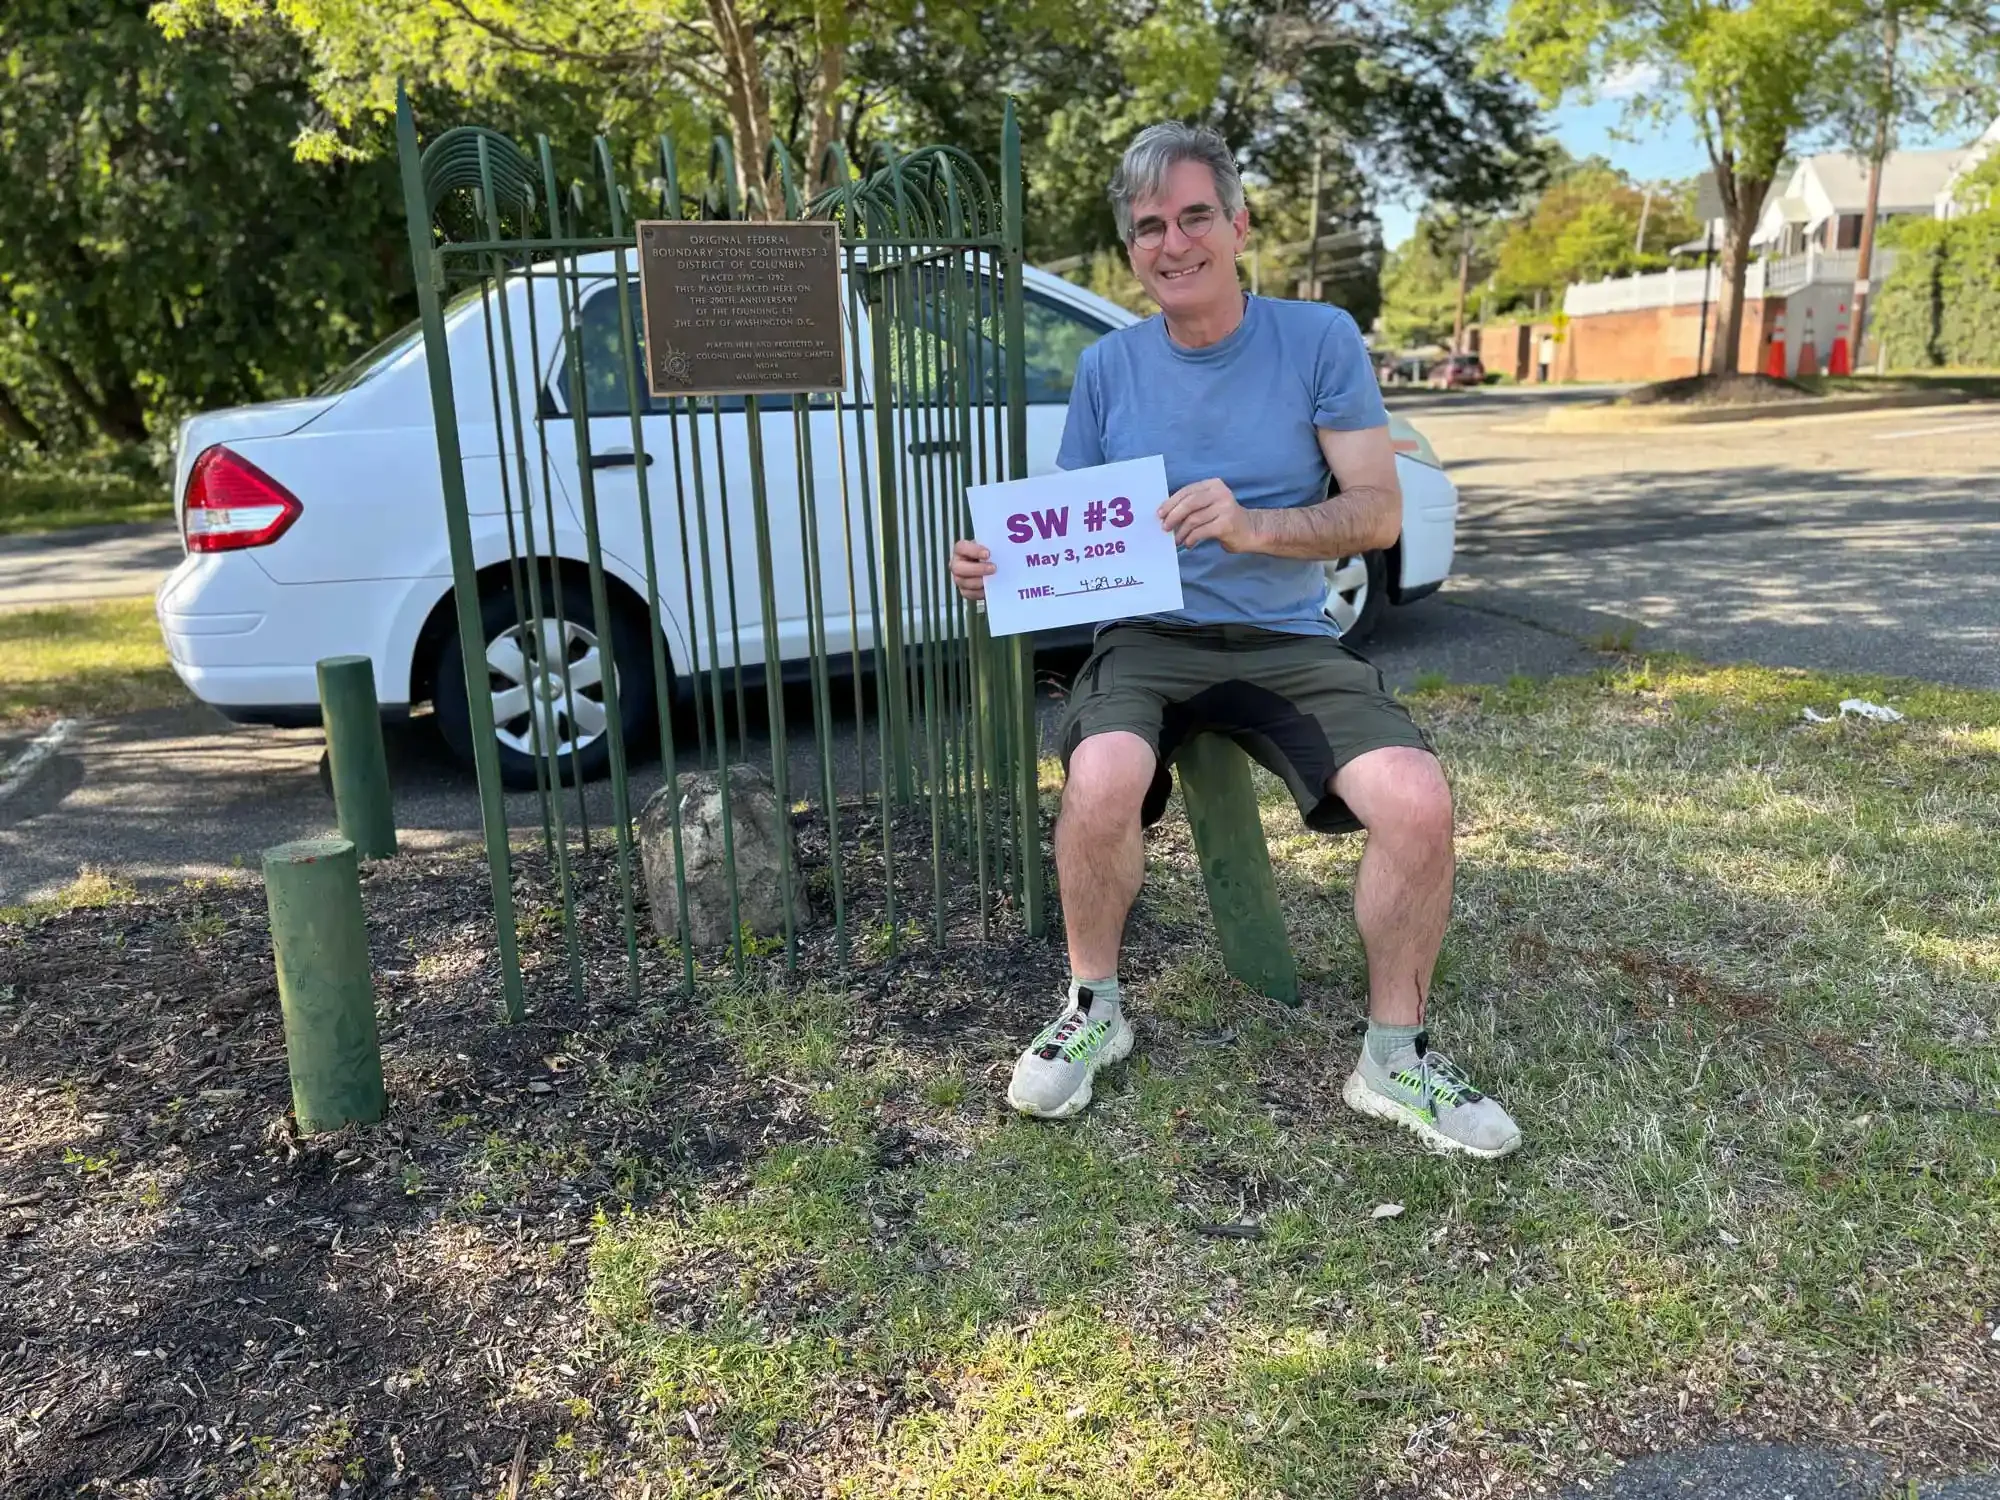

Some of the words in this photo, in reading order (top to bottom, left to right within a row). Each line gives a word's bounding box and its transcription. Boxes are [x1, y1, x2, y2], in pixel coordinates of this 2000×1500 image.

[690, 235, 742, 245] ORIGINAL
[747, 235, 791, 245] FEDERAL
[652, 248, 713, 257] BOUNDARY
[718, 247, 751, 257] STONE
[756, 247, 817, 257] SOUTHWEST
[677, 260, 725, 270] DISTRICT
[730, 260, 744, 270] OF
[750, 260, 806, 270] COLUMBIA
[701, 274, 734, 282] PLACED
[767, 274, 785, 282] 1792
[675, 284, 695, 294] THIS
[699, 284, 733, 294] PLAQUE
[736, 284, 769, 293] PLACED
[797, 284, 811, 292] ON
[690, 296, 706, 305] THE
[709, 296, 736, 304] 200TH
[739, 296, 798, 305] ANNIVERSARY
[696, 308, 707, 316] OF
[712, 308, 729, 316] THE
[732, 308, 778, 316] FOUNDING
[674, 320, 692, 328] THE
[696, 320, 716, 328] CITY
[719, 320, 732, 328] OF
[736, 318, 793, 327] WASHINGTON
[1006, 506, 1069, 544] SW
[1083, 496, 1134, 532] #3
[1026, 553, 1060, 568] May
[1064, 549, 1080, 563] 3,
[1084, 541, 1126, 559] 2026
[1080, 576, 1110, 591] 4:29
[1018, 585, 1055, 600] TIME:
